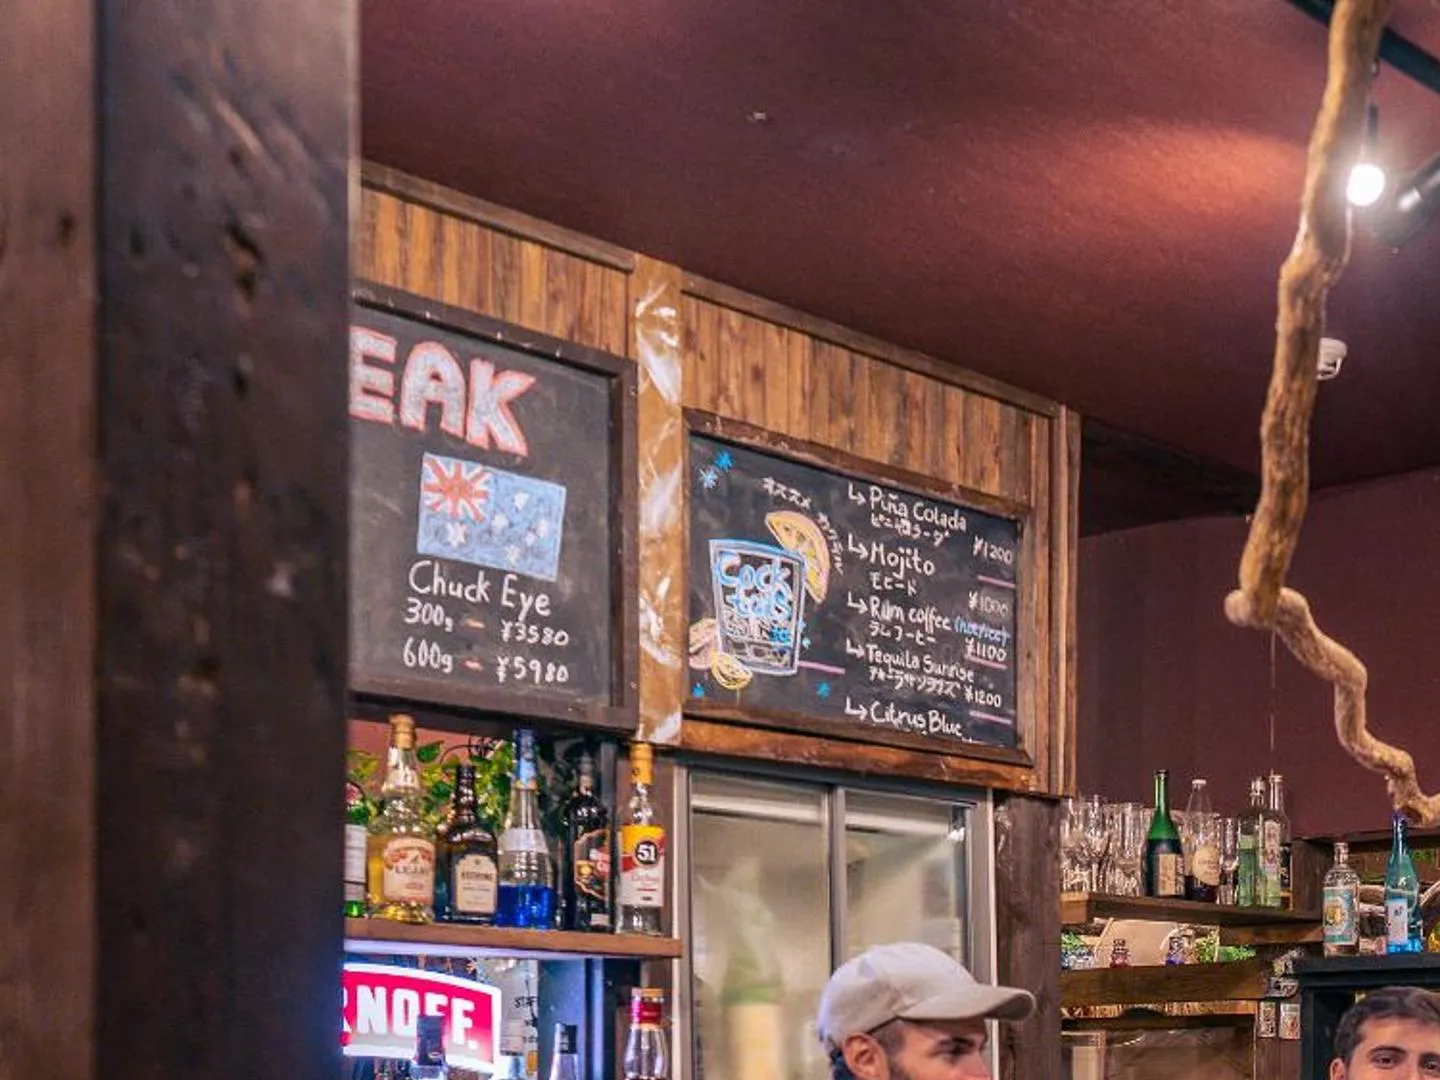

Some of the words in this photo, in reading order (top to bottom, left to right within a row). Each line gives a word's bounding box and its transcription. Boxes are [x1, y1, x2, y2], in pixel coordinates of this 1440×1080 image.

[349, 326, 536, 456] EAK
[869, 485, 909, 518] Piña
[913, 501, 967, 532] Colada
[869, 541, 935, 580] Mojito
[972, 535, 1013, 565] ¥1200
[408, 560, 490, 603] Chuck
[501, 573, 551, 622] Eye
[404, 597, 453, 632] 300g
[501, 619, 569, 646] ¥3580
[869, 596, 905, 623] Rum
[908, 604, 952, 635] coffee
[404, 637, 453, 673] 600g
[496, 655, 569, 683] ¥5980
[866, 644, 920, 672] Tequila
[923, 654, 975, 683] Sunrise
[965, 637, 1007, 662] ¥1100
[964, 685, 1002, 708] ¥1200
[870, 700, 926, 731] Citrus
[927, 709, 963, 737] Blue
[636, 843, 656, 862] 51
[343, 984, 479, 1049] NOFF.
